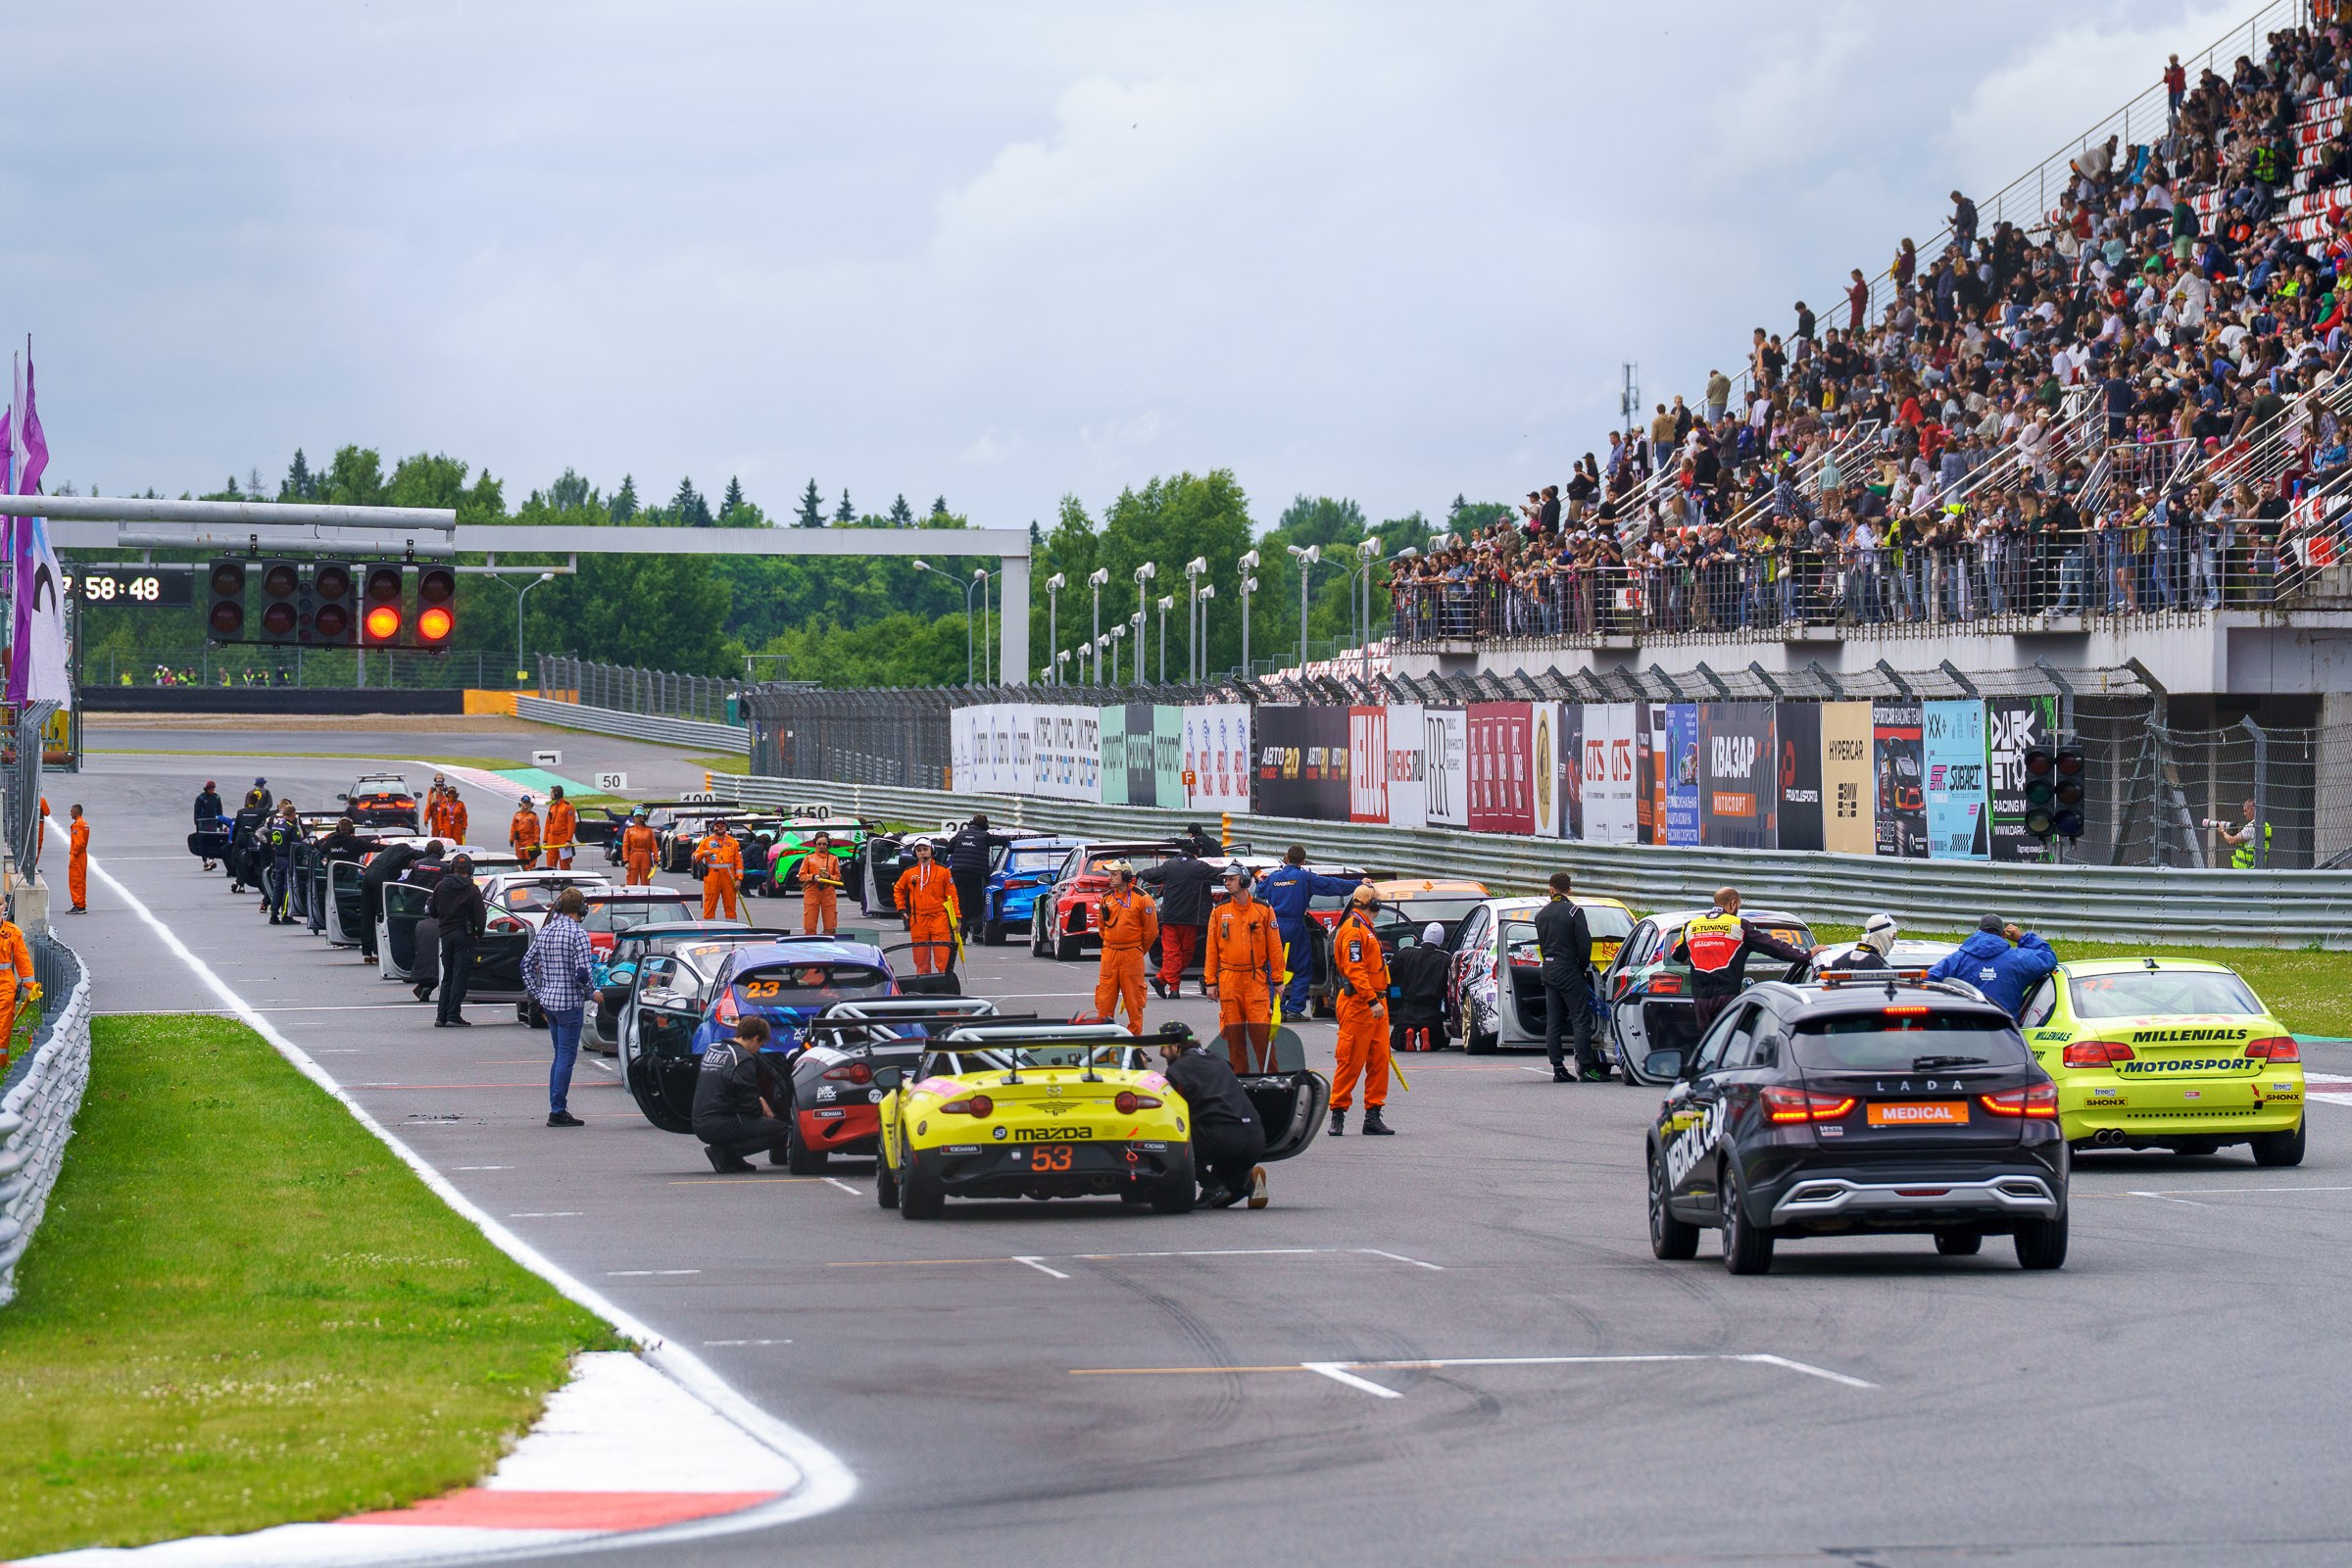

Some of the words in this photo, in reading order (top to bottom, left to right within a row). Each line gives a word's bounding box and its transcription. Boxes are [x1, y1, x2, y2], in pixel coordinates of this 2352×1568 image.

[1990, 710, 2035, 750] DARK
[1711, 736, 1755, 778] КВАЗАР
[1829, 740, 1863, 760] HYPERCAR
[1261, 747, 1285, 764] АВТО
[1283, 747, 1300, 780] 20
[1586, 740, 1605, 781] GTS
[1611, 739, 1632, 781] GTS
[1990, 746, 2027, 792] STO
[603, 775, 620, 788] 50
[1186, 772, 1193, 783] F
[1844, 782, 1858, 800] BMW
[1715, 796, 1746, 811] МОТОСПОРТ
[1993, 800, 2019, 812] RACING
[1510, 910, 1531, 920] 11
[746, 981, 780, 999] 23
[2083, 980, 2115, 992] 92
[2034, 1031, 2072, 1042] MILLENIALS
[2132, 1028, 2247, 1043] MILLENIALS
[2124, 1058, 2256, 1073] MOTORSPORT
[1877, 1080, 1963, 1092] LADA
[1883, 1107, 1952, 1119] MEDICAL
[1666, 1118, 1705, 1192] MEDICAL
[1703, 1097, 1727, 1151] CAR
[1031, 1145, 1073, 1171] 53
